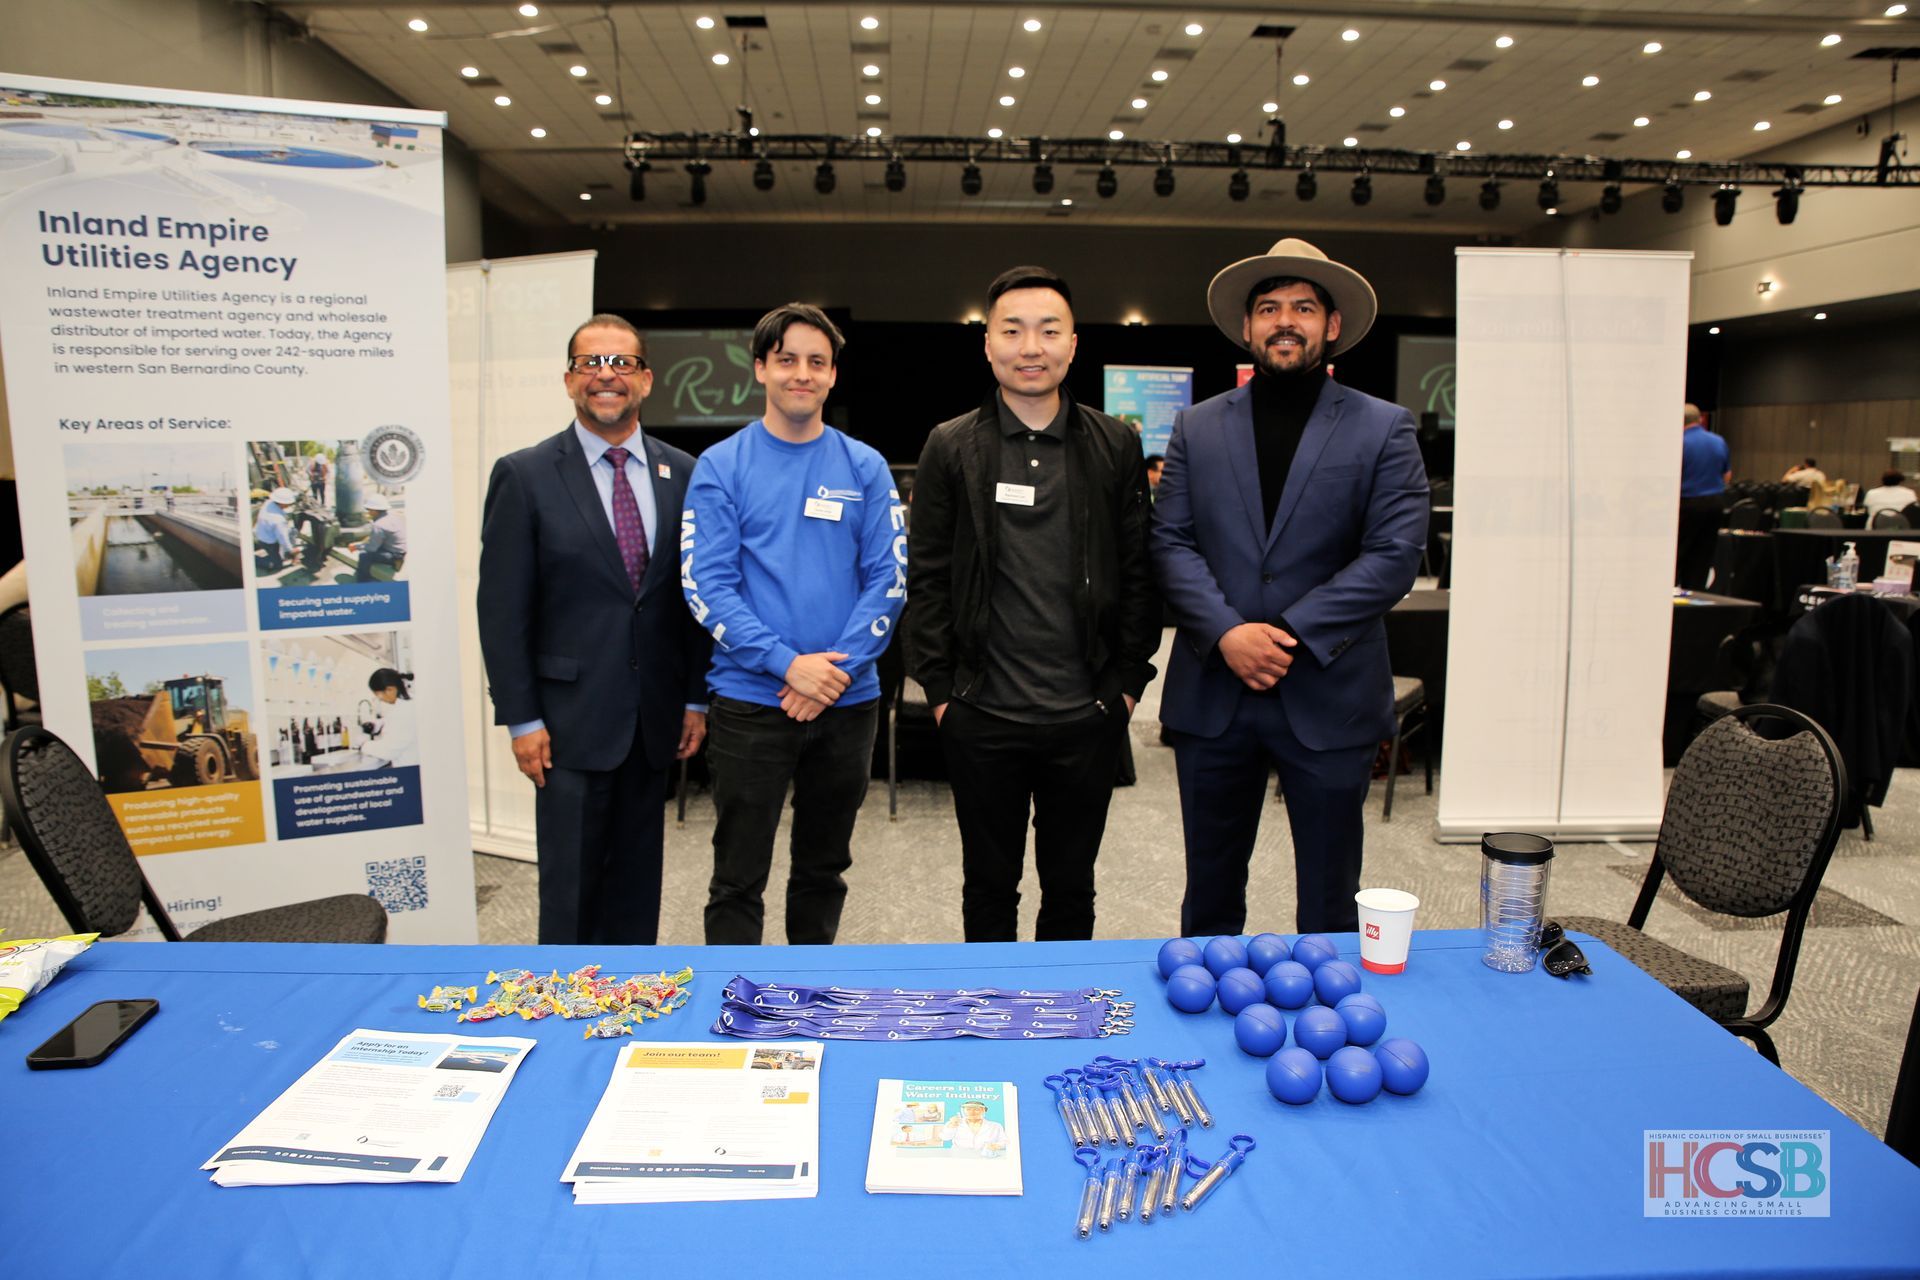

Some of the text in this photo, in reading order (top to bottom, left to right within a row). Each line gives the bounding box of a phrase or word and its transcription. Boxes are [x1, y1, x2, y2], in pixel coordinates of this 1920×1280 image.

[38, 210, 269, 248] Inland Empire
[42, 243, 298, 281] Utilities Agency
[47, 287, 367, 307] Inland Empire Utilities Agency is a regional
[49, 307, 388, 323] wastewater treatment agency and wholesale
[50, 325, 392, 343] distributor of imported water. Today, the Agency
[52, 343, 394, 359] is responsible for serving over 242-square miles
[54, 362, 308, 376] in western San Bernardino County.
[59, 417, 231, 433] Key Areas of Service:
[278, 593, 390, 607] Securing and supplying
[293, 776, 398, 793] Promoting sustainable
[313, 794, 323, 803] of
[324, 789, 384, 804] groundwater
[385, 786, 404, 795] and
[123, 799, 176, 810] Producing
[295, 798, 392, 816] development of local
[124, 806, 225, 822] renewable products
[126, 825, 151, 834] such
[152, 824, 165, 832] as
[167, 819, 210, 830] recycled
[296, 818, 324, 827] water
[174, 832, 195, 840] and
[167, 895, 222, 912] Hiring!
[1366, 926, 1379, 938] illy
[945, 1091, 1000, 1100] Industry
[975, 1084, 994, 1092] the
